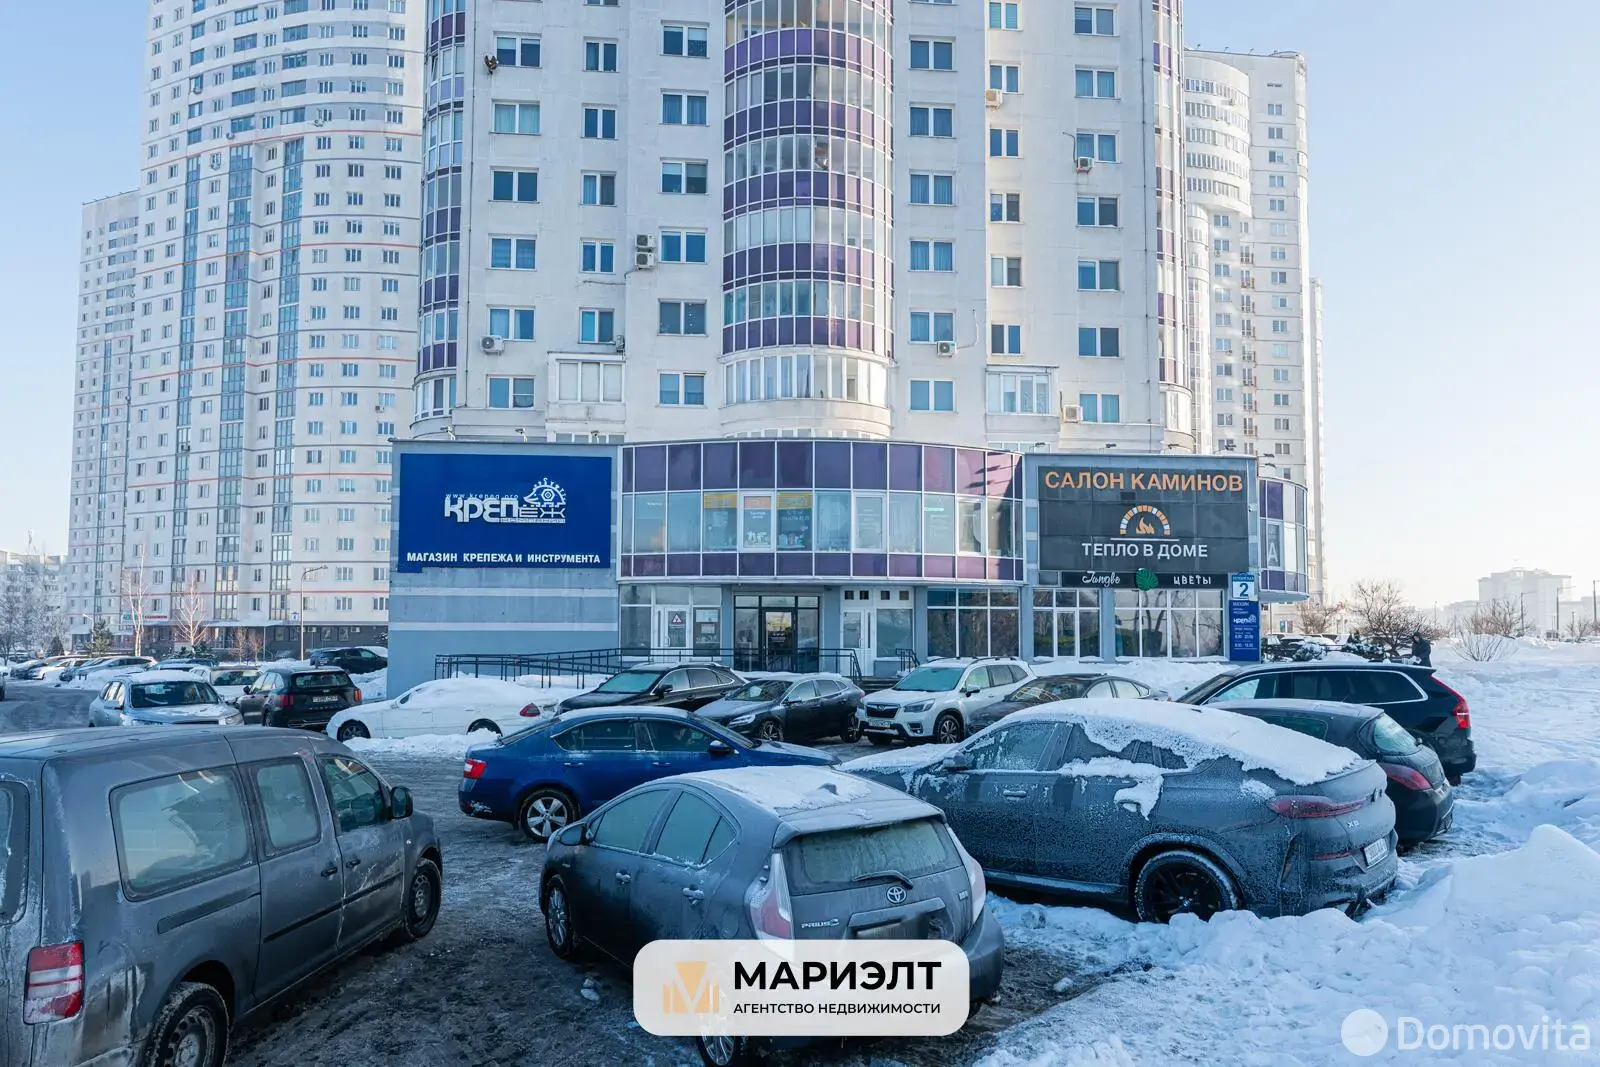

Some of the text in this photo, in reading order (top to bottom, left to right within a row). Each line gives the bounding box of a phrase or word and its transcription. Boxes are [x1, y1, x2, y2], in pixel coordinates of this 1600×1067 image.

[1045, 471, 1243, 492] САЛОН КАМИНОВ
[407, 552, 601, 563] МАГАЗИН КРЕПЕЖА И ИНСТРУМЕНТА
[1082, 543, 1208, 560] ТЕПЛО В ДОМЕ
[1173, 574, 1212, 585] ЦВЕТЫ
[1239, 582, 1249, 597] 2
